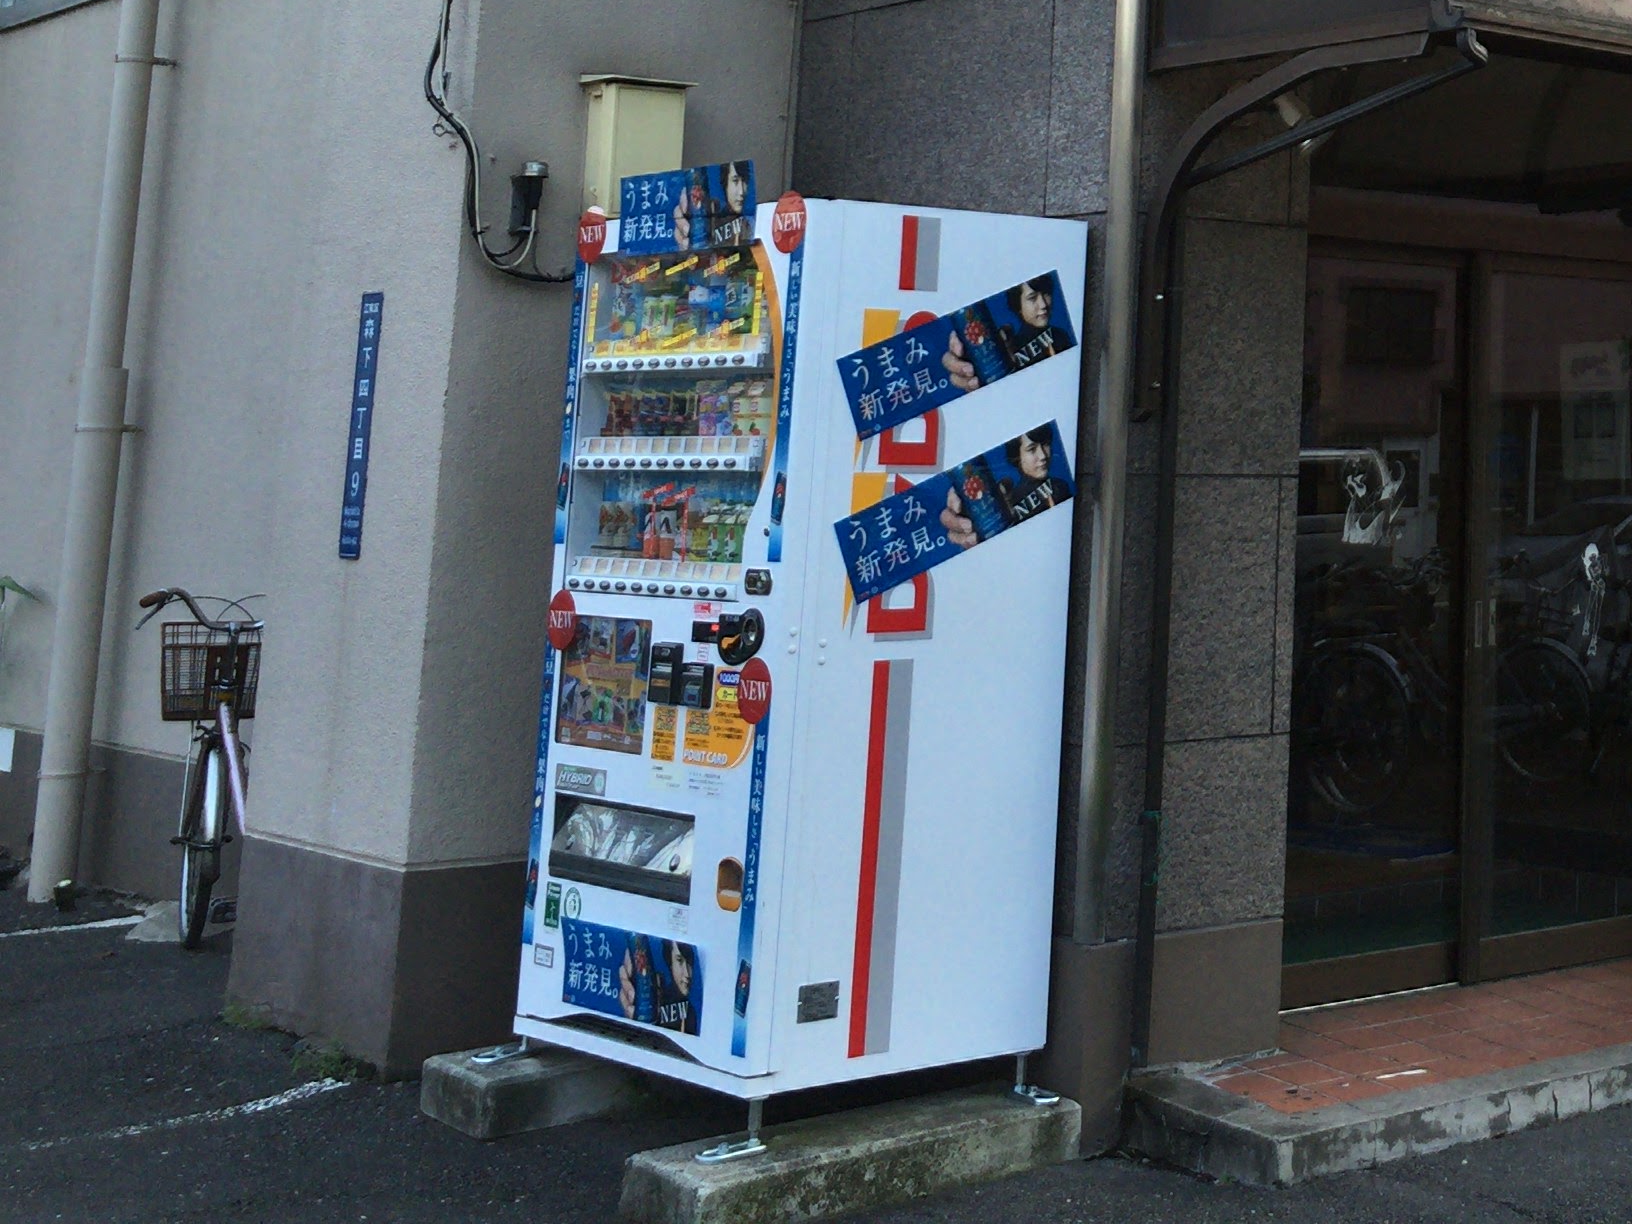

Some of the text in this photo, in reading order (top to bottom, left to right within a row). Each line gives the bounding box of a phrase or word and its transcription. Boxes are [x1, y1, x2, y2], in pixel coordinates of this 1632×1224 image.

[625, 180, 669, 212] うまみ
[578, 225, 605, 244] NEW
[623, 213, 673, 243] 新発見。
[714, 216, 744, 245] NEW
[773, 212, 804, 233] NEW
[1014, 327, 1054, 366] NEW
[852, 337, 929, 391] うまみ
[858, 367, 948, 421] 新発見。
[1014, 478, 1054, 520] NEW
[849, 496, 927, 552] うまみ
[856, 526, 946, 584] 新発見。
[549, 610, 575, 629] NEW
[739, 679, 769, 702] NEW
[568, 923, 613, 960] うまみ
[568, 960, 619, 999] 新発見。
[659, 1000, 690, 1024] NEW
